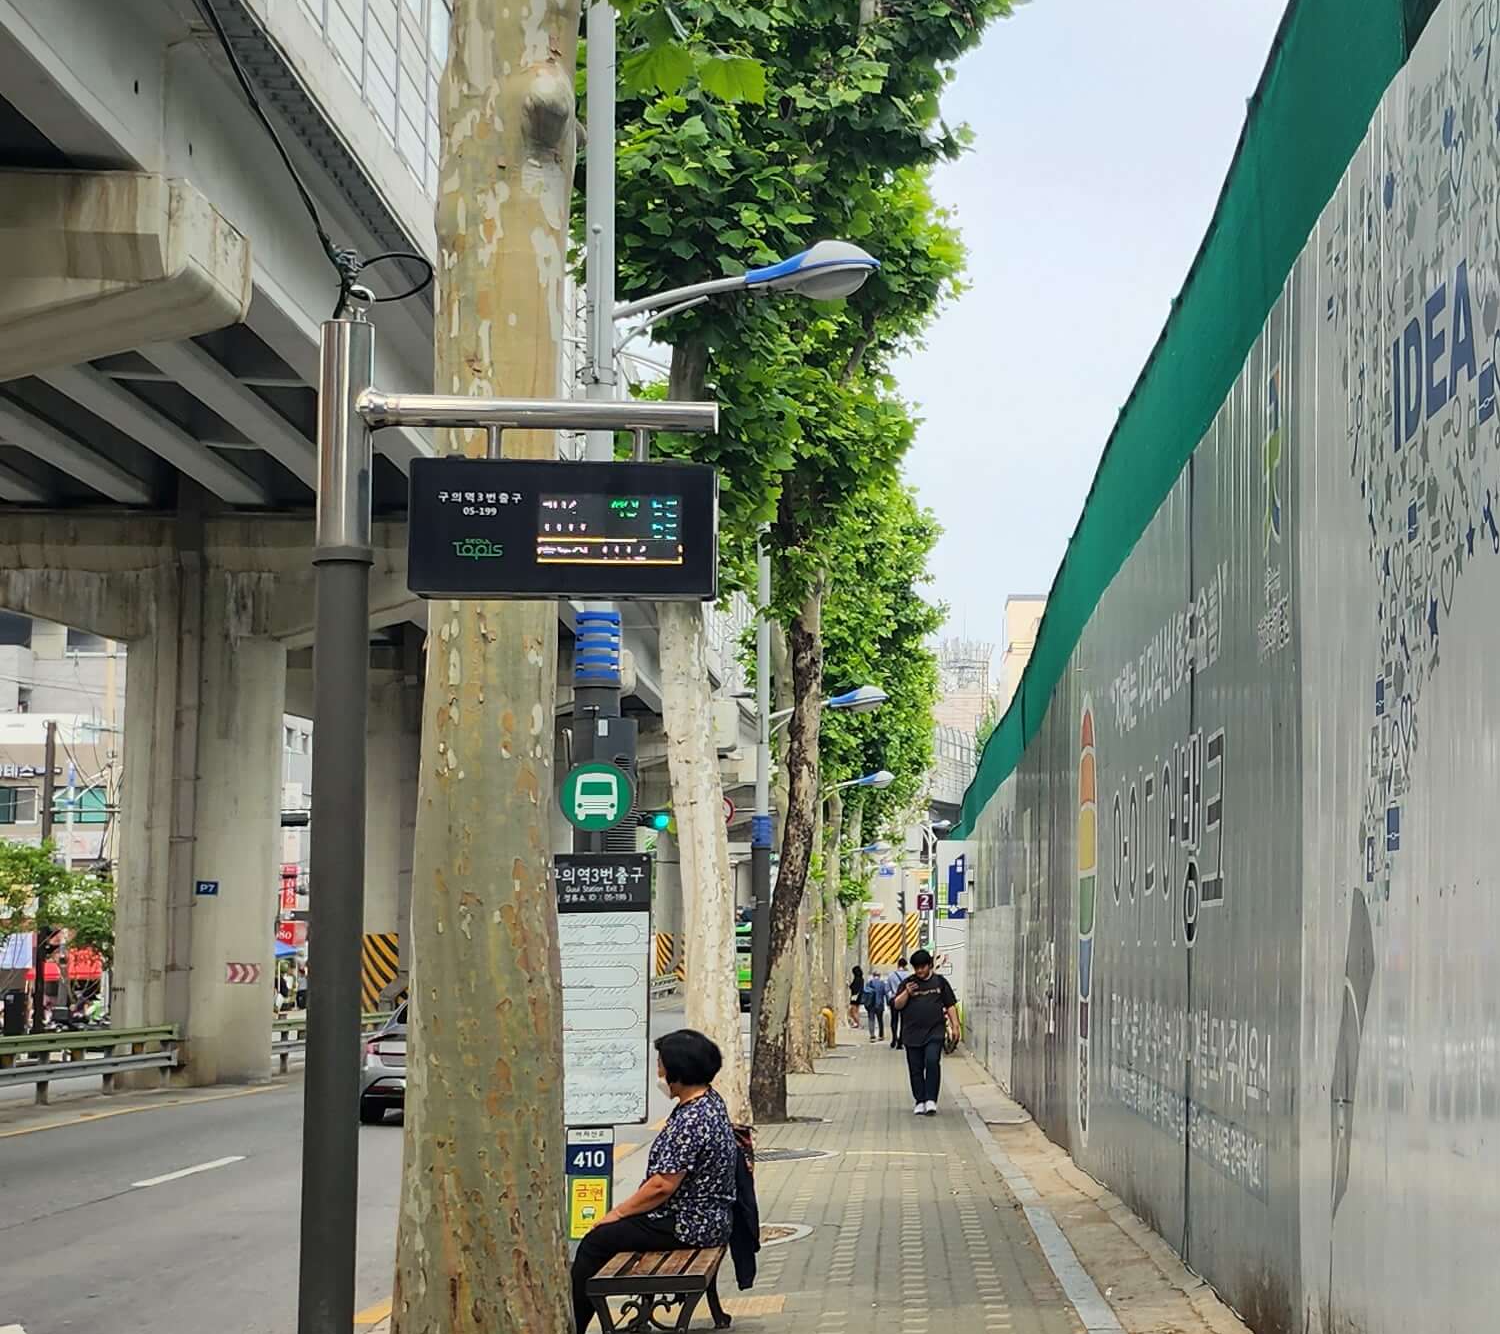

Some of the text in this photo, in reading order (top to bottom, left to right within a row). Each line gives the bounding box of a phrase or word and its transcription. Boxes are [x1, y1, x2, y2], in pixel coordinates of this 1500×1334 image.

[1393, 258, 1477, 453] IDEA
[438, 491, 522, 504] 구의역3번출구
[462, 506, 498, 516] 05-199
[1112, 726, 1226, 948] 아이디어뱅크
[573, 1150, 605, 1168] 410
